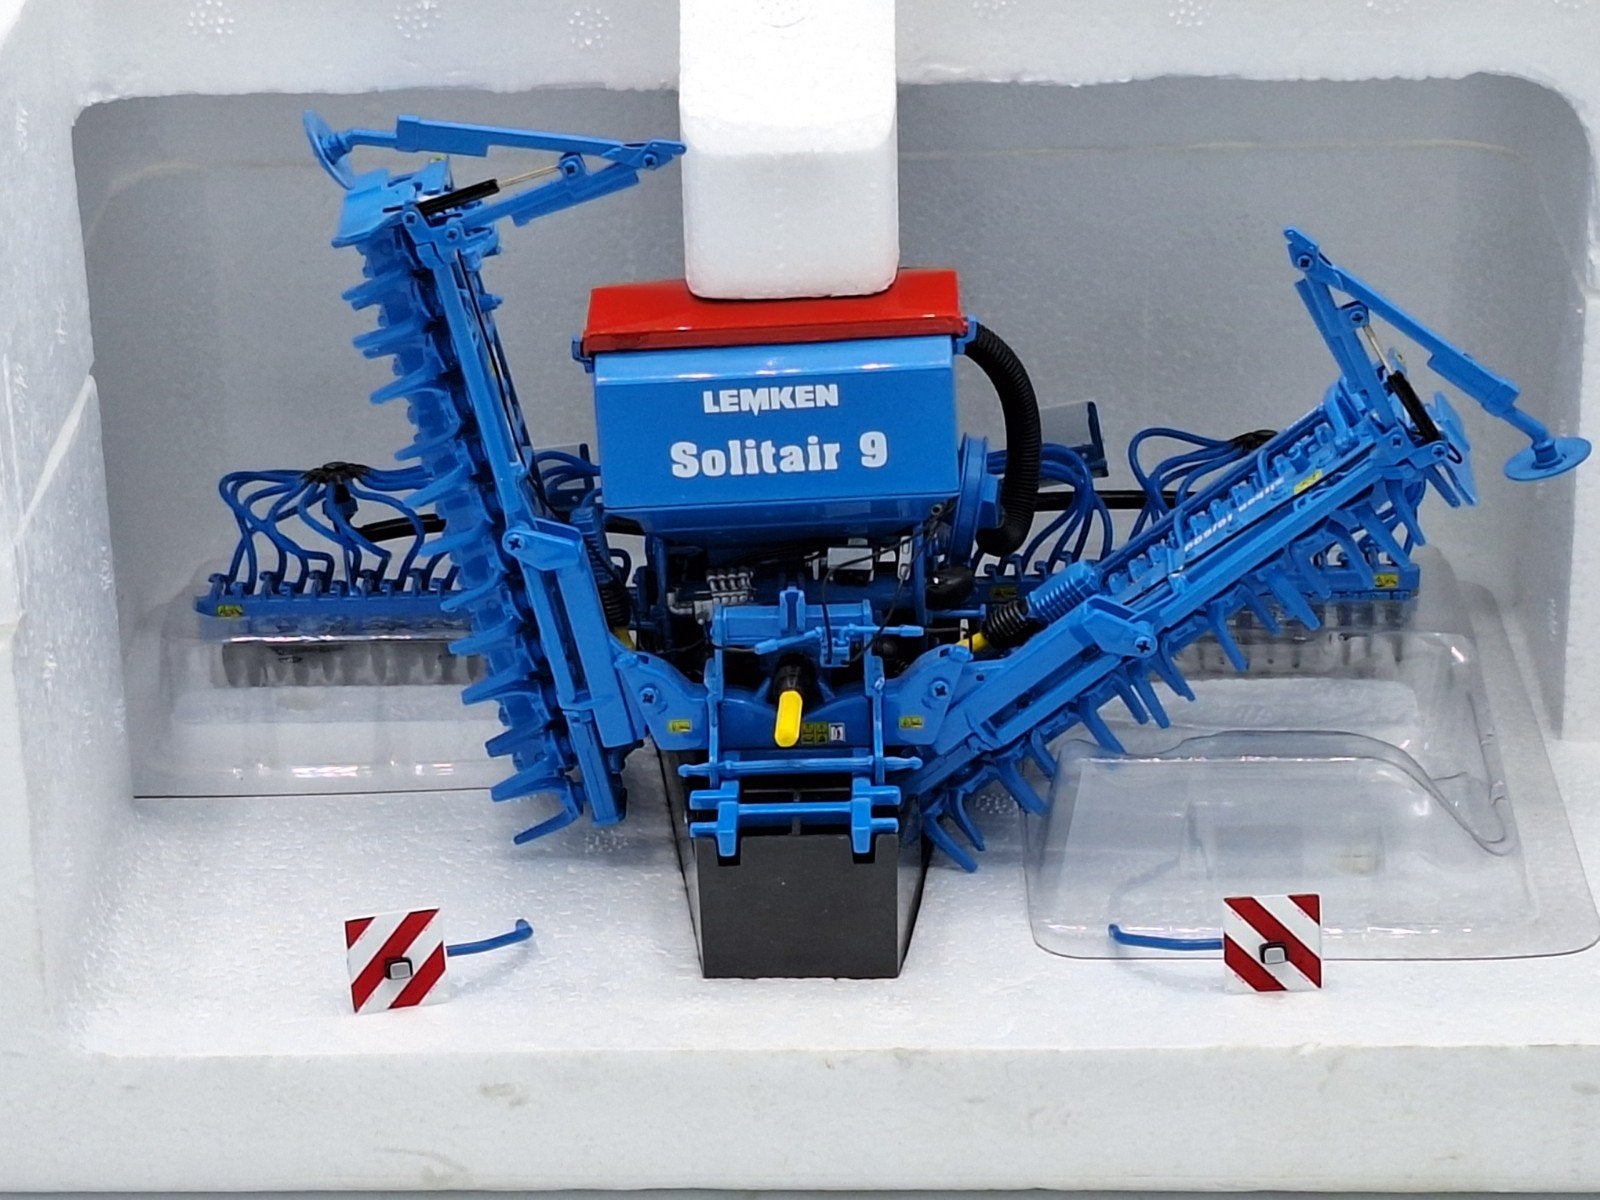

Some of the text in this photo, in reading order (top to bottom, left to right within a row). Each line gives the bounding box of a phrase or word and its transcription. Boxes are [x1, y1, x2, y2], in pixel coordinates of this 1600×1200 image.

[703, 384, 839, 416] LEMKEN
[671, 431, 888, 478] Solitair 9
